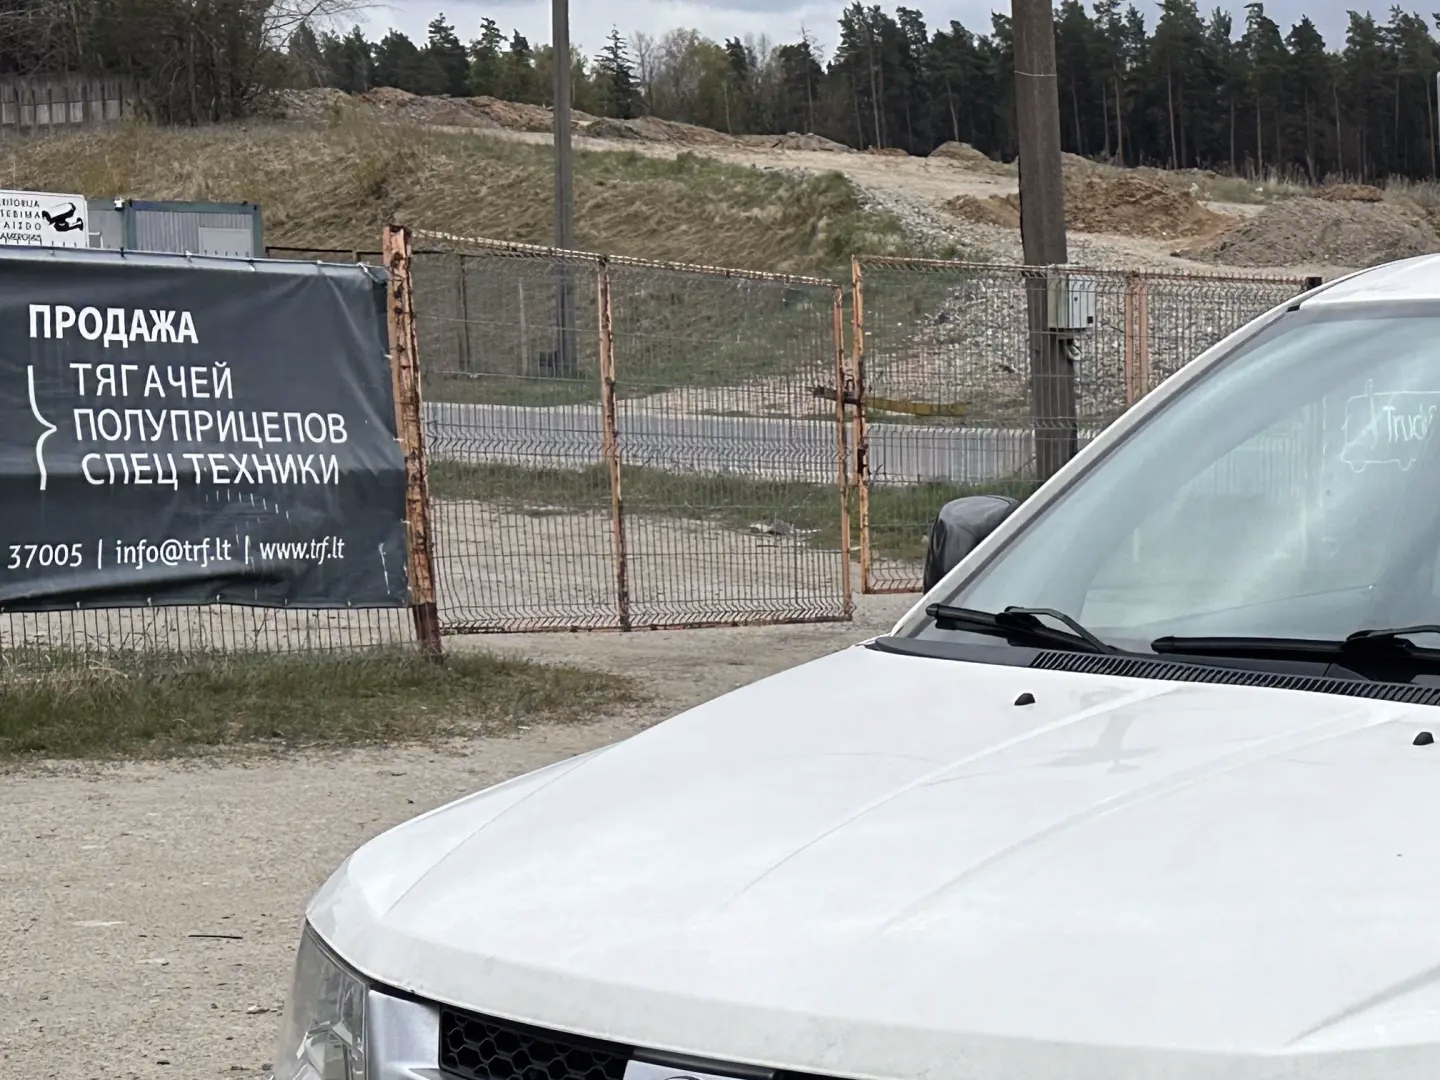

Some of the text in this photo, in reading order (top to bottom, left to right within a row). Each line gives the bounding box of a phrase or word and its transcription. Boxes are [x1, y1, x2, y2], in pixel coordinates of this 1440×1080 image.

[28, 304, 199, 348] ПРОДАЖА
[69, 361, 234, 399] ТЯГАЧЕЙ
[73, 408, 348, 449] ПОЛУПРИЦЕПОВ
[7, 535, 345, 569] 37005 info@trf.lt www.trf.lt
